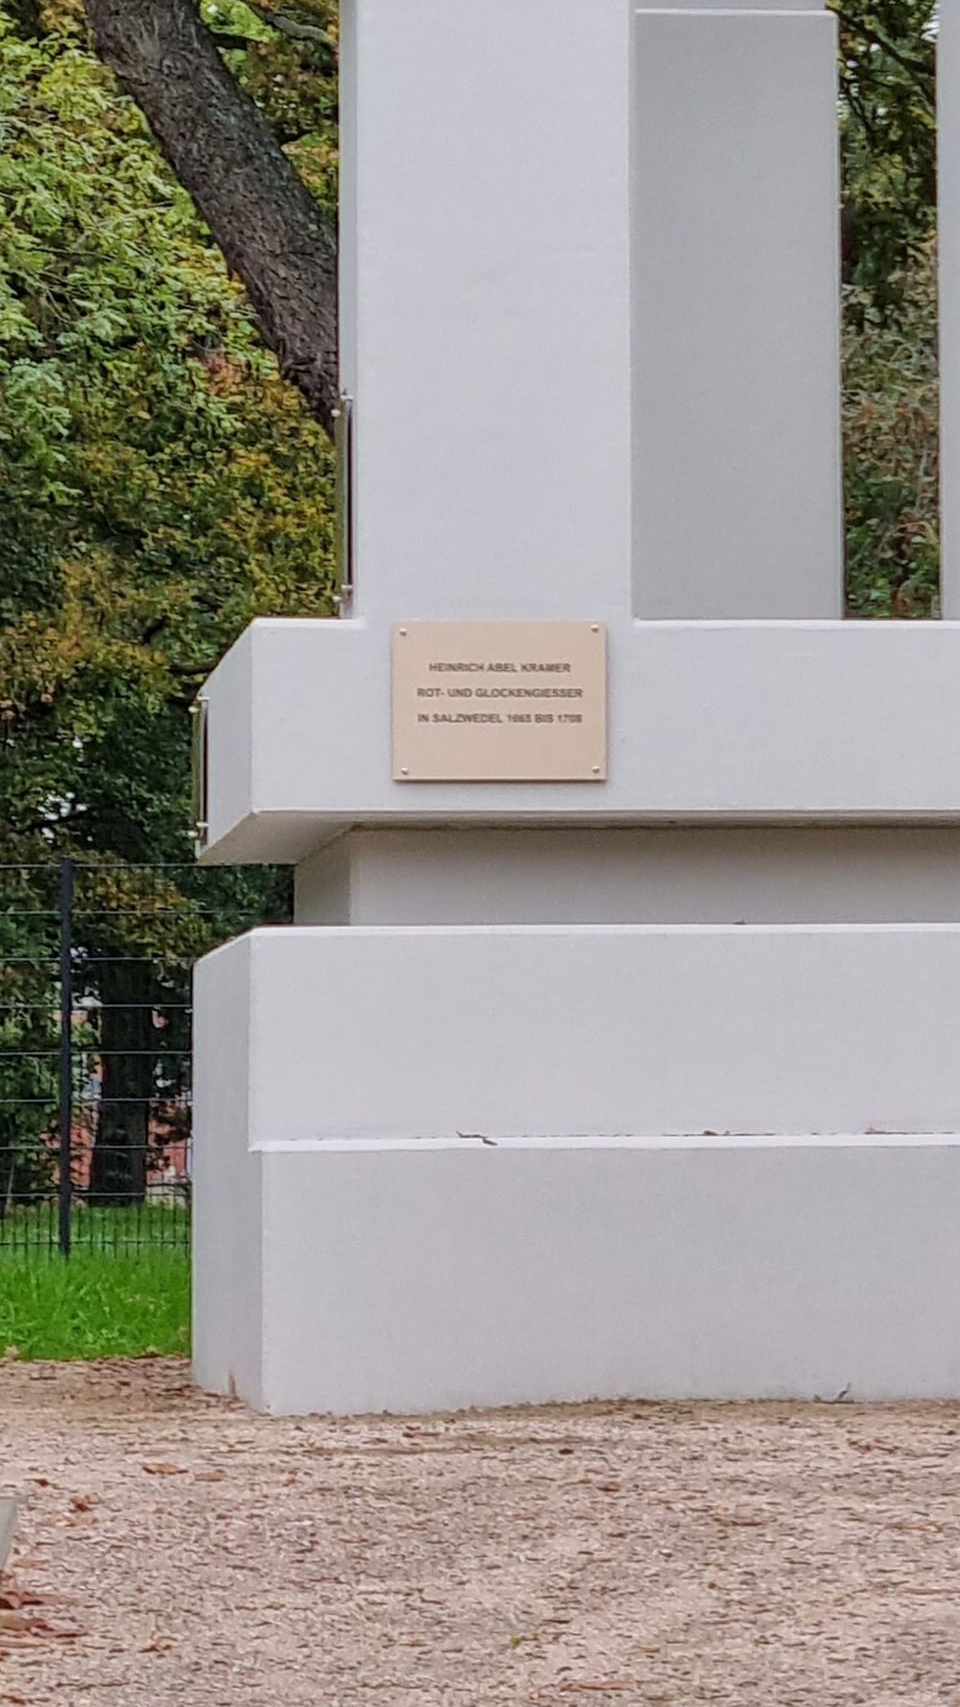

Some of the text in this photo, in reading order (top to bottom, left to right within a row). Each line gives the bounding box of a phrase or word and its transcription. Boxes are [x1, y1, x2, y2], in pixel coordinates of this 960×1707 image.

[428, 662, 571, 673] HEINRICH ABEL KRAMER
[416, 688, 583, 698] ROT- UND GLOCKENGIESSER
[417, 713, 430, 723] IN
[432, 713, 503, 724] SALZWEDEL
[534, 713, 554, 724] BIS
